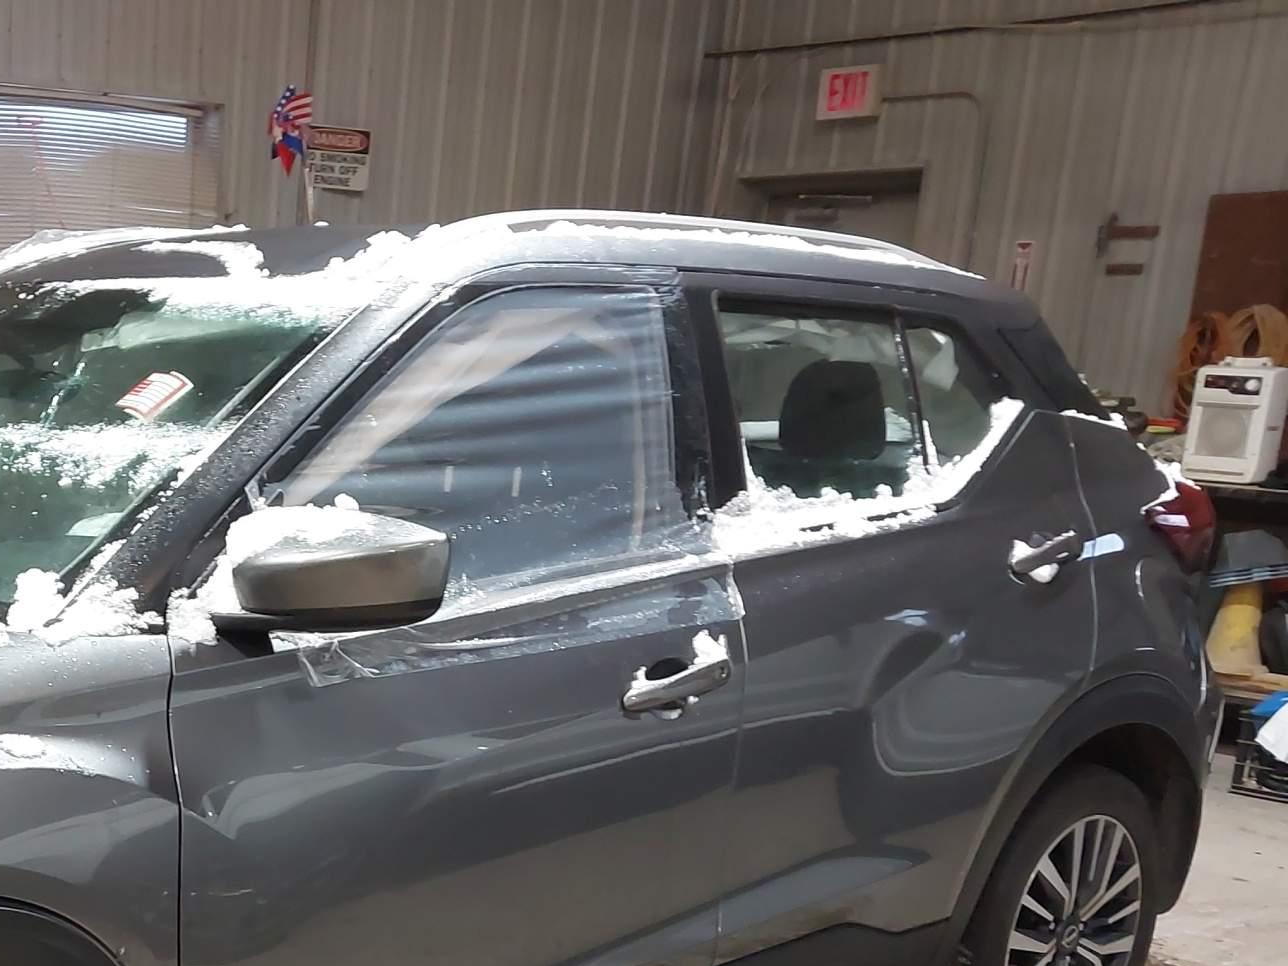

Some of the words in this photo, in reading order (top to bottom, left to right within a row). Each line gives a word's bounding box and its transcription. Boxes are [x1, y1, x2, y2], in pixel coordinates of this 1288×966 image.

[827, 71, 869, 111] EXIT
[320, 154, 367, 165] SMOKING
[309, 163, 335, 173] TURN
[339, 165, 359, 176] OFF
[314, 175, 352, 187] ENGINE
